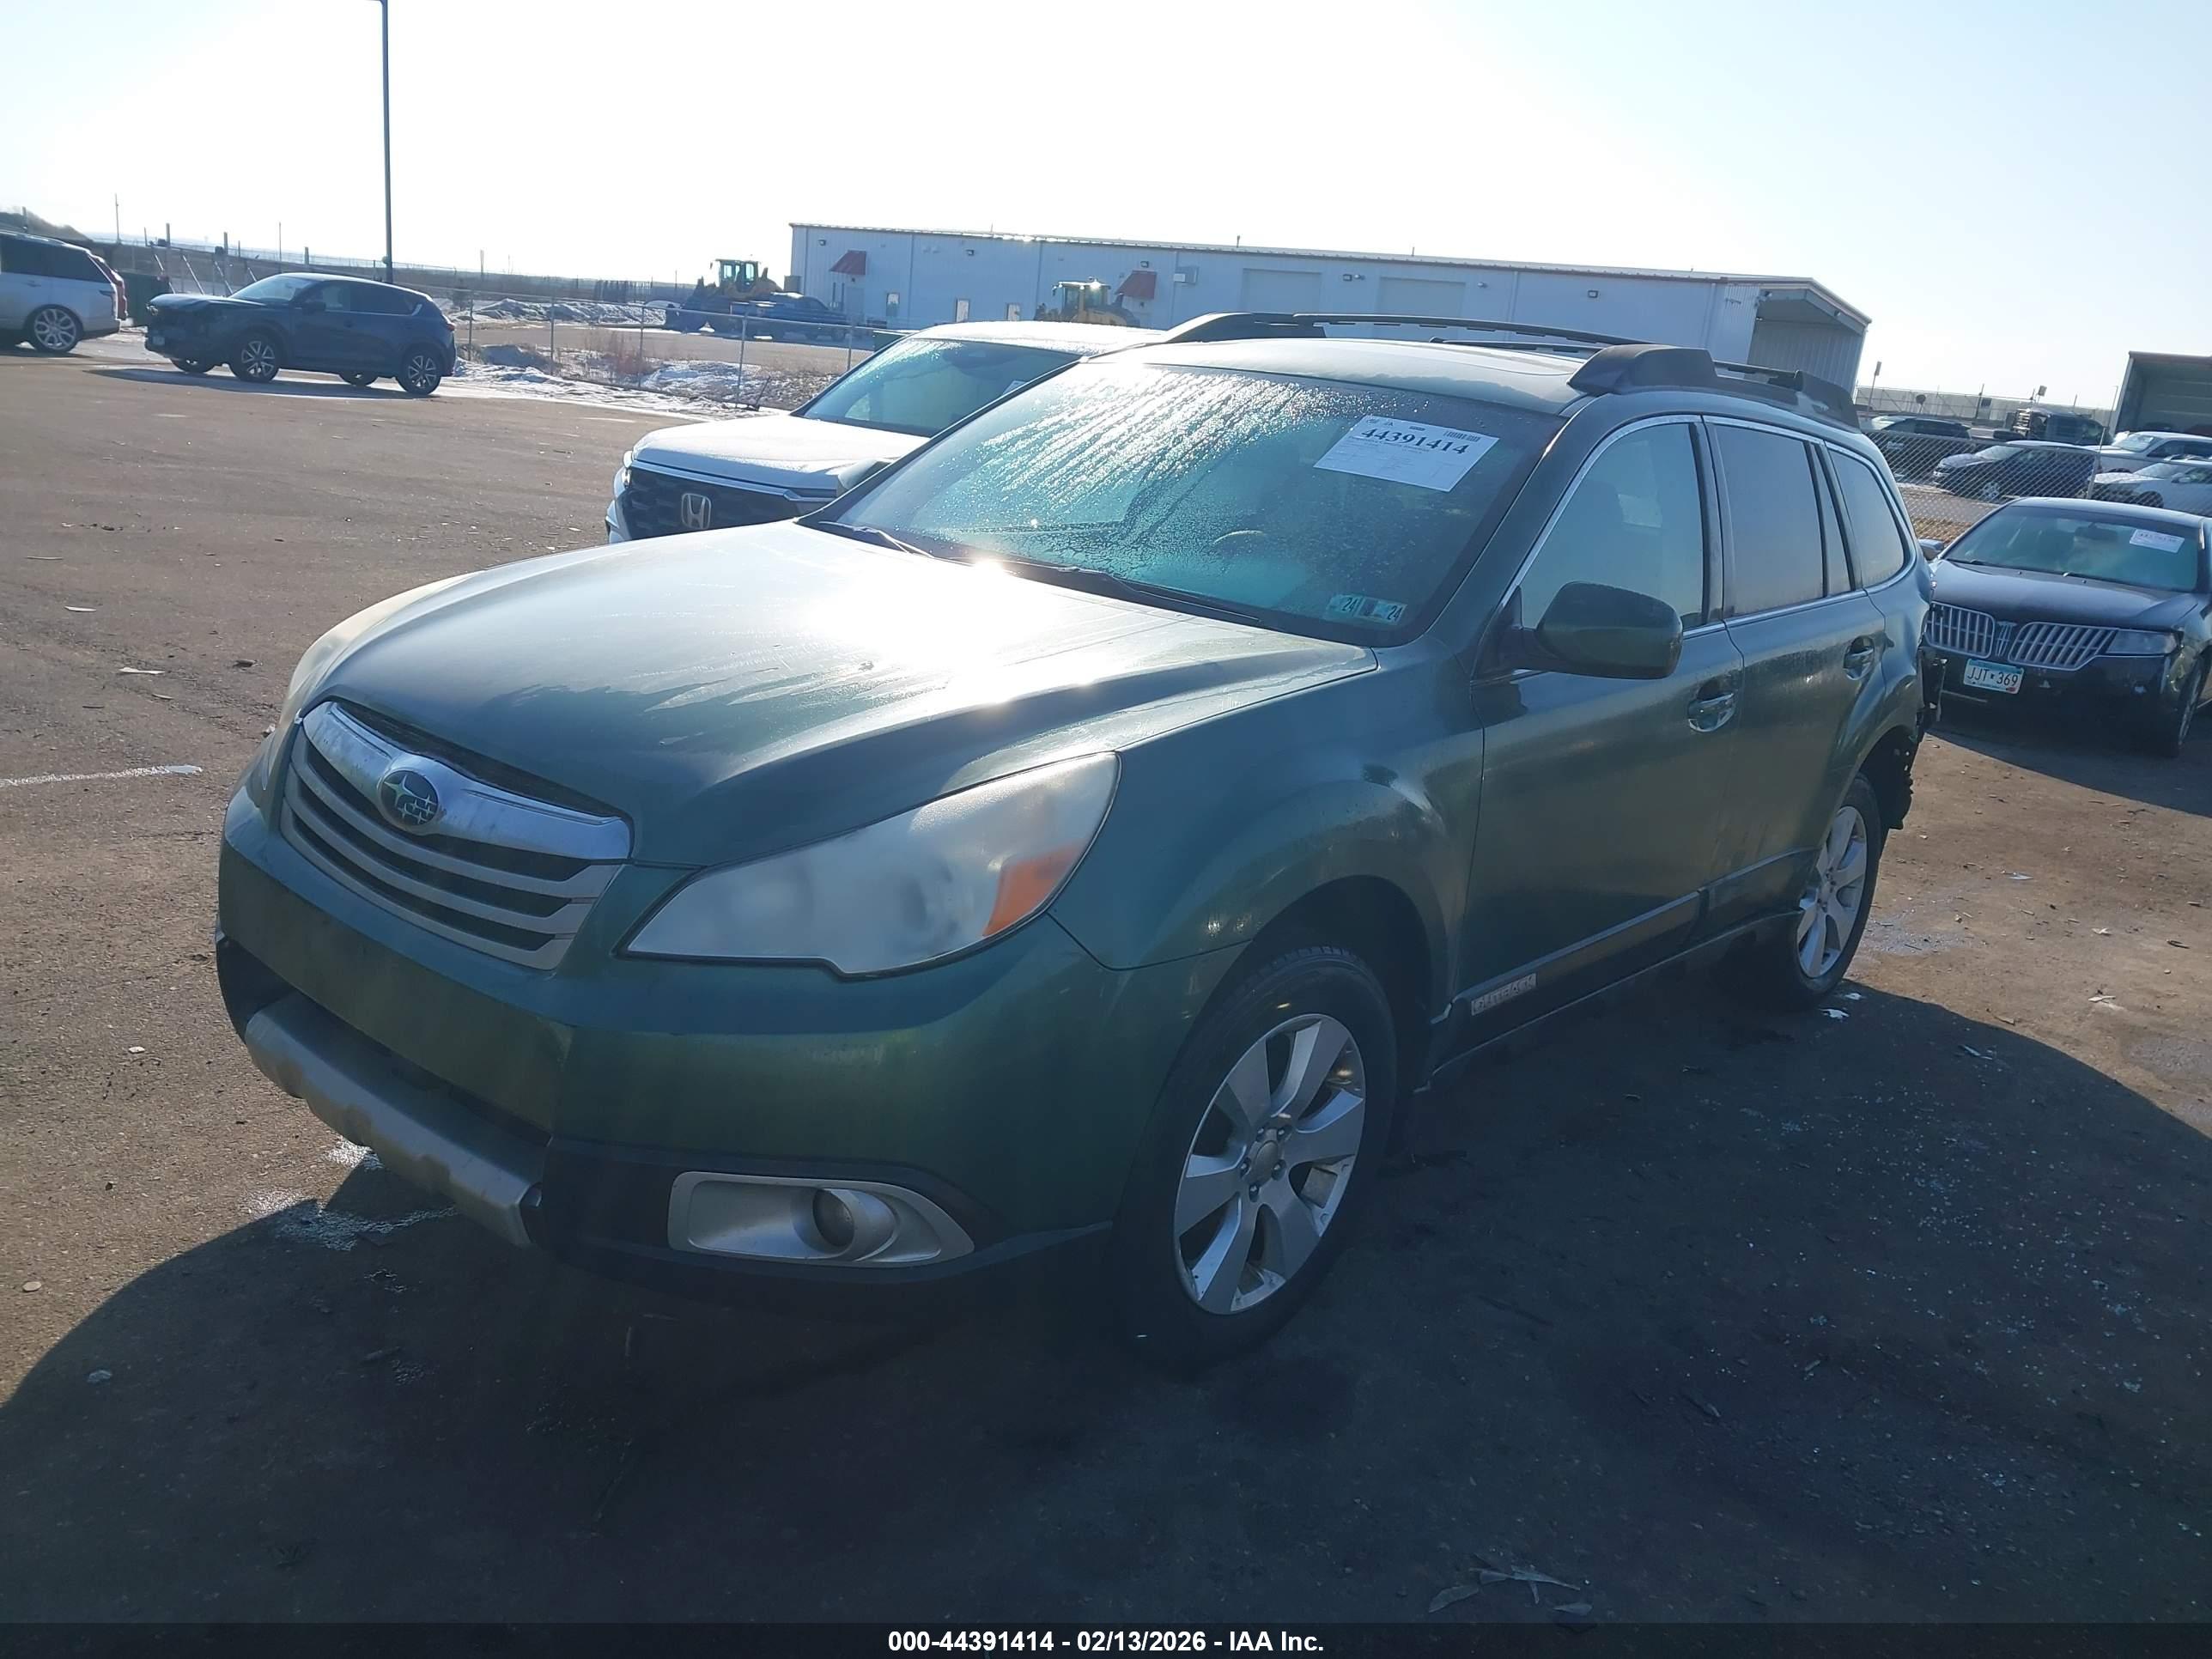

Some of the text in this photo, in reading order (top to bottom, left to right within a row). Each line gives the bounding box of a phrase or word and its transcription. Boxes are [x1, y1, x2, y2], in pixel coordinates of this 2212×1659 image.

[1361, 428, 1470, 454] 44391414
[1341, 597, 1358, 612] 24
[1387, 605, 1403, 622] 24
[1967, 666, 1990, 682] JJT
[1996, 671, 2019, 686] 369
